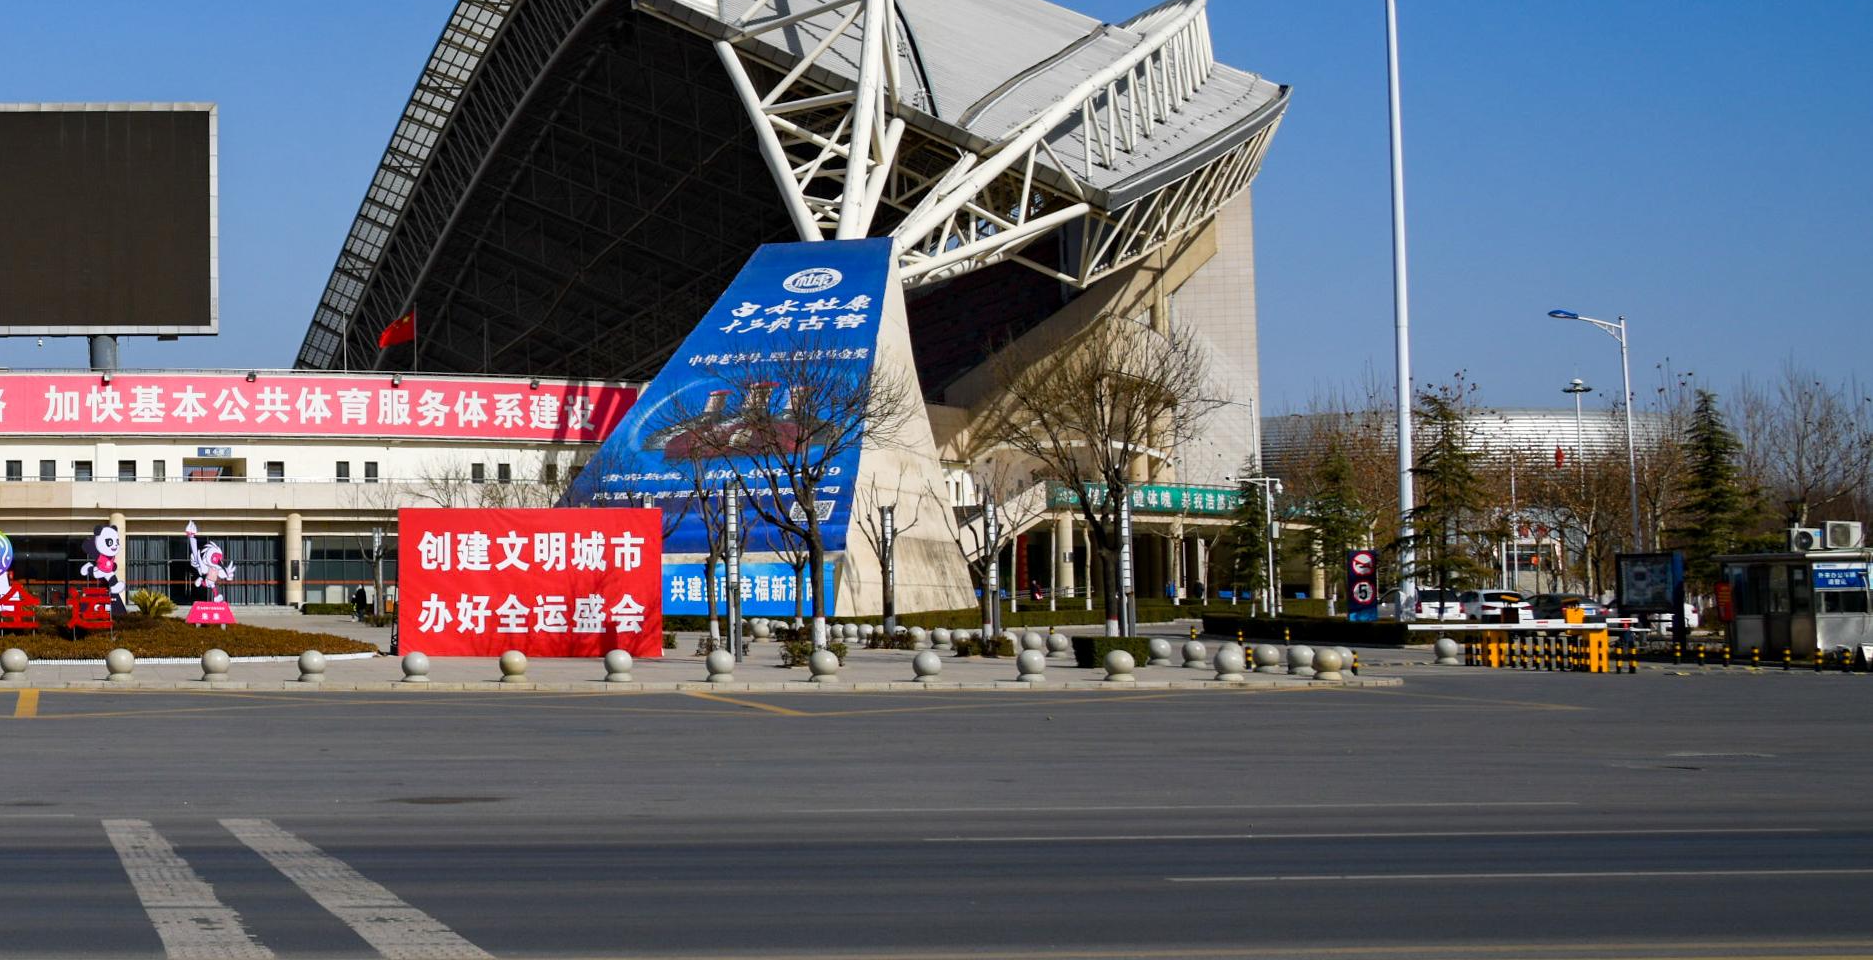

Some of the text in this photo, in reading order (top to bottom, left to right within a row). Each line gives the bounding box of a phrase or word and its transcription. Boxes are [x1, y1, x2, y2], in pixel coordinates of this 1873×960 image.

[44, 385, 596, 431] 加快基本公共体育服务体系建设
[417, 530, 645, 572] 创建文明城市
[417, 592, 645, 634] 办好全运盛会
[1358, 584, 1368, 600] 5
